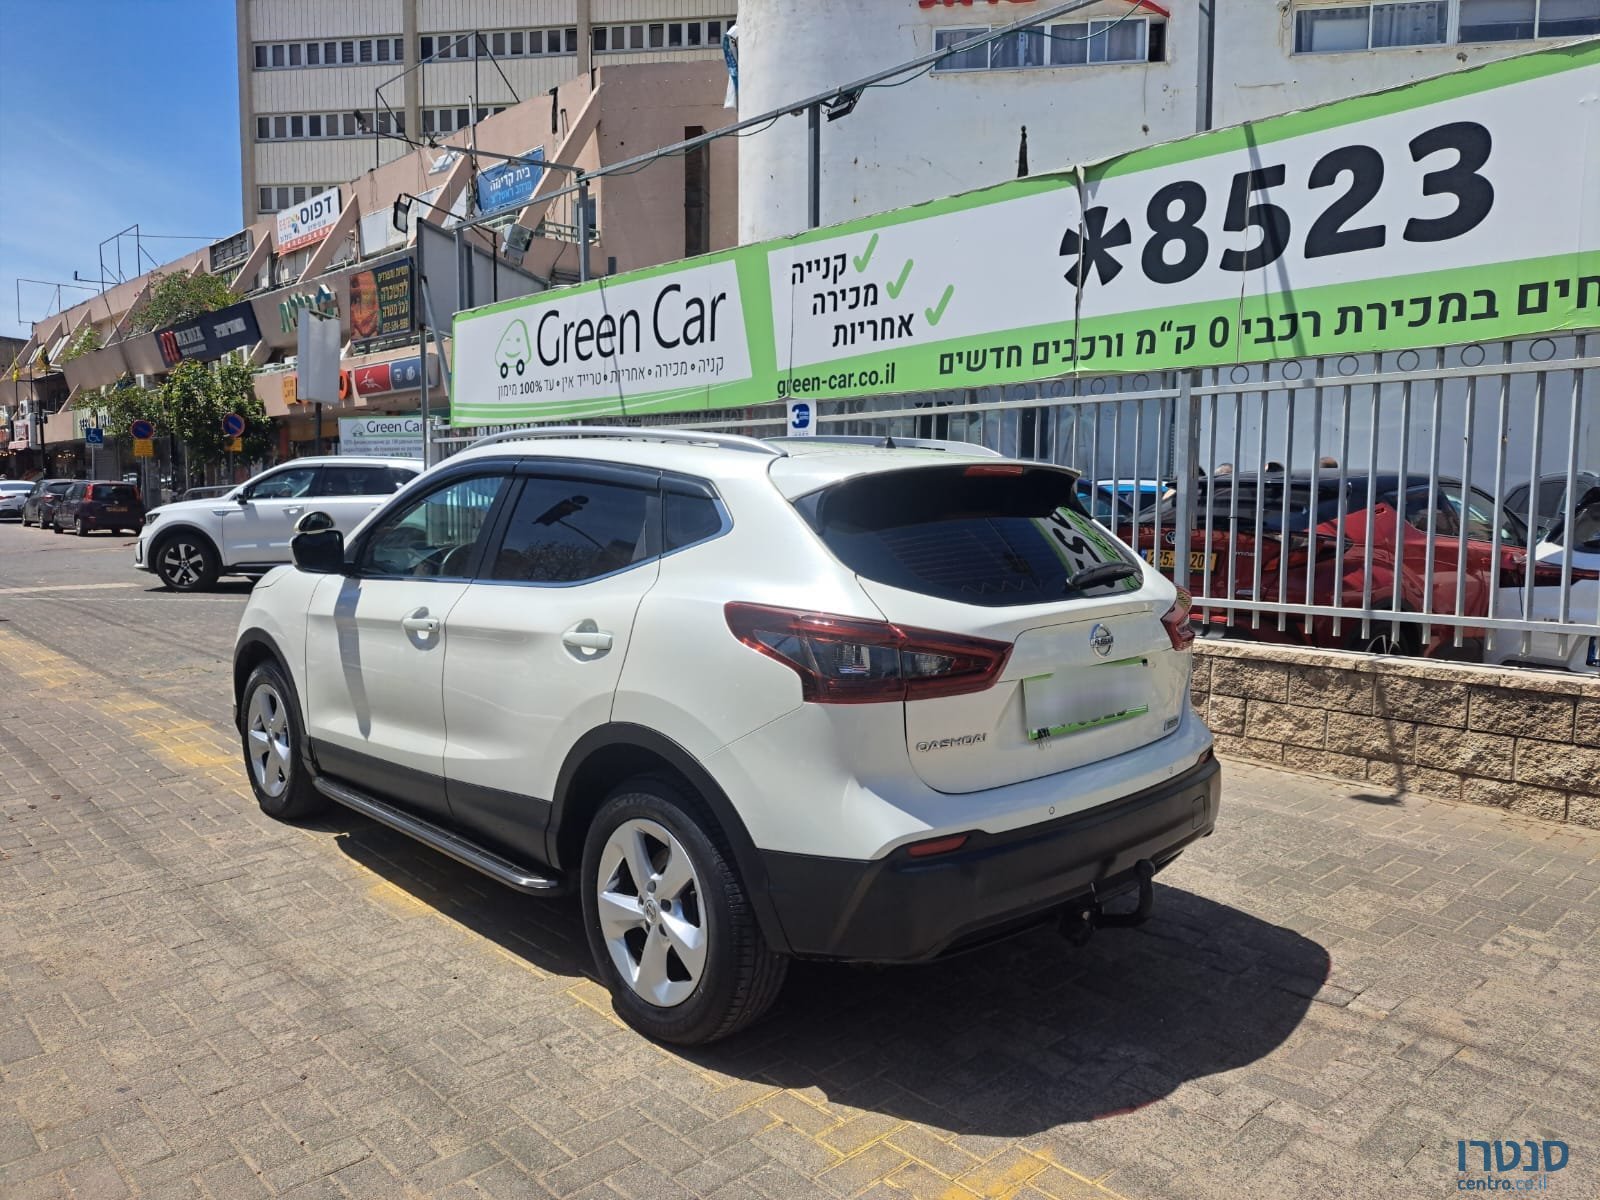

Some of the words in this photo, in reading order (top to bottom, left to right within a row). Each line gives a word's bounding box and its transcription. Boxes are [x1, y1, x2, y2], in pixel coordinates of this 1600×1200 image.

[516, 167, 531, 181] בית
[300, 196, 332, 225] דפוס
[791, 253, 847, 285] קנייה
[812, 283, 878, 315] מכירה
[1335, 289, 1499, 336] במכירת
[537, 309, 640, 366] Green
[653, 284, 726, 349] Car
[832, 313, 914, 347] אחריות
[1208, 316, 1229, 348] 0
[1242, 310, 1321, 344] רכבי
[938, 345, 1022, 375] חדשים
[1032, 333, 1123, 365] ורכבים
[577, 373, 602, 387] טרייד
[610, 366, 645, 383] אחריות
[655, 361, 688, 378] מכירה
[699, 356, 724, 375] קניה
[777, 362, 895, 398] green-car.co.il
[498, 384, 518, 400] מימון
[520, 380, 542, 394] 100%
[544, 379, 555, 391] עד
[561, 375, 574, 392] אין
[366, 420, 402, 433] Green
